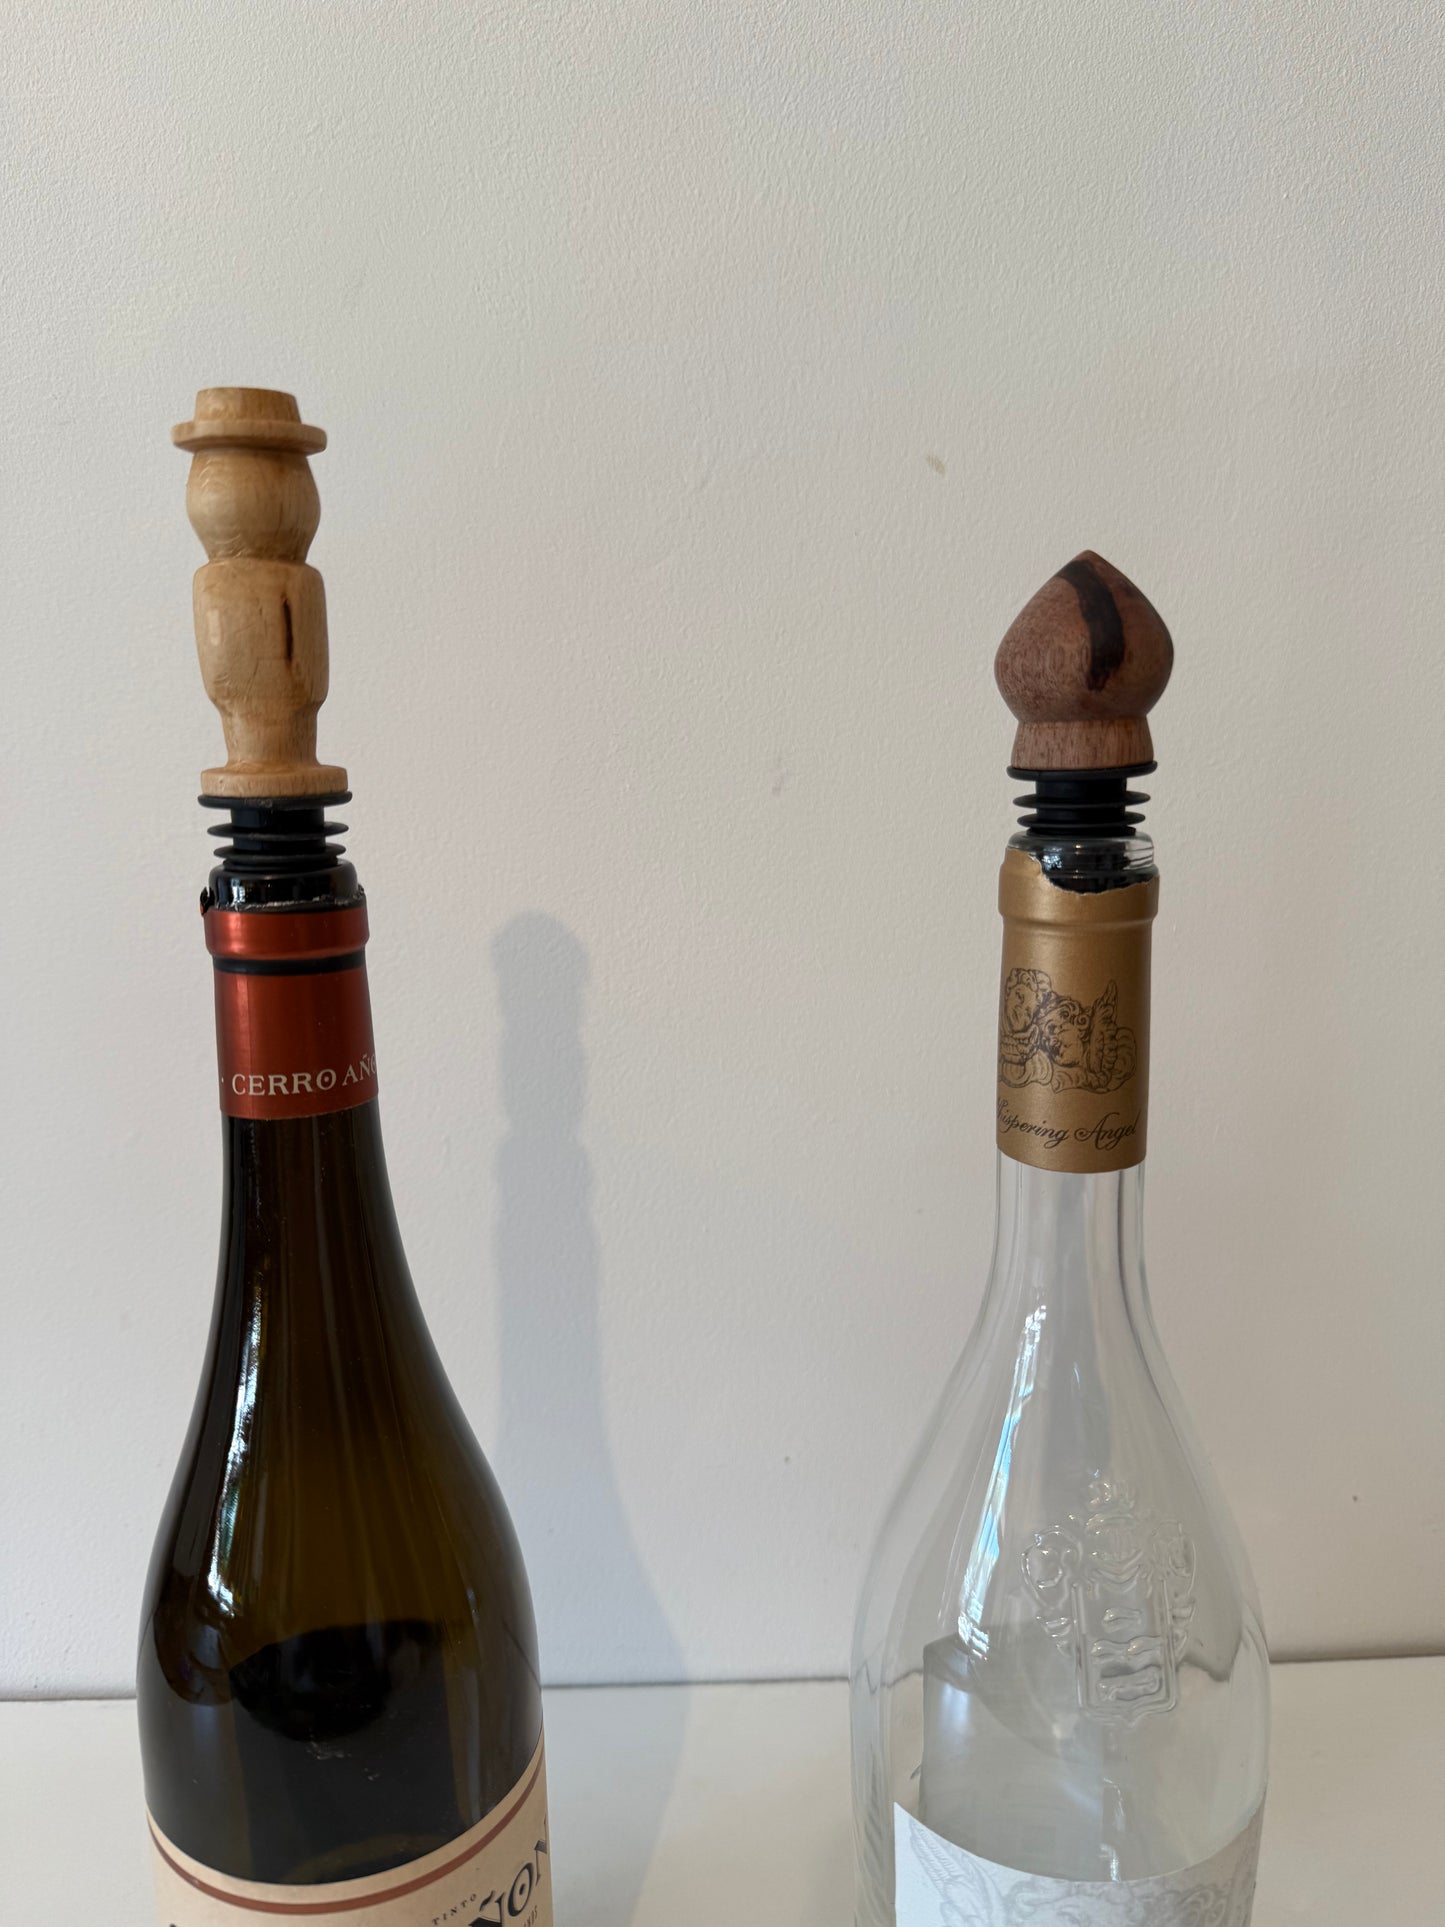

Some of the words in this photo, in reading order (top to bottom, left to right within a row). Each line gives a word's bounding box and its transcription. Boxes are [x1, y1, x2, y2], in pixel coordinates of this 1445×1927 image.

[231, 1068, 337, 1096] CERRO
[1073, 1109, 1142, 1150] Angel
[431, 1893, 477, 1926] TINTO
